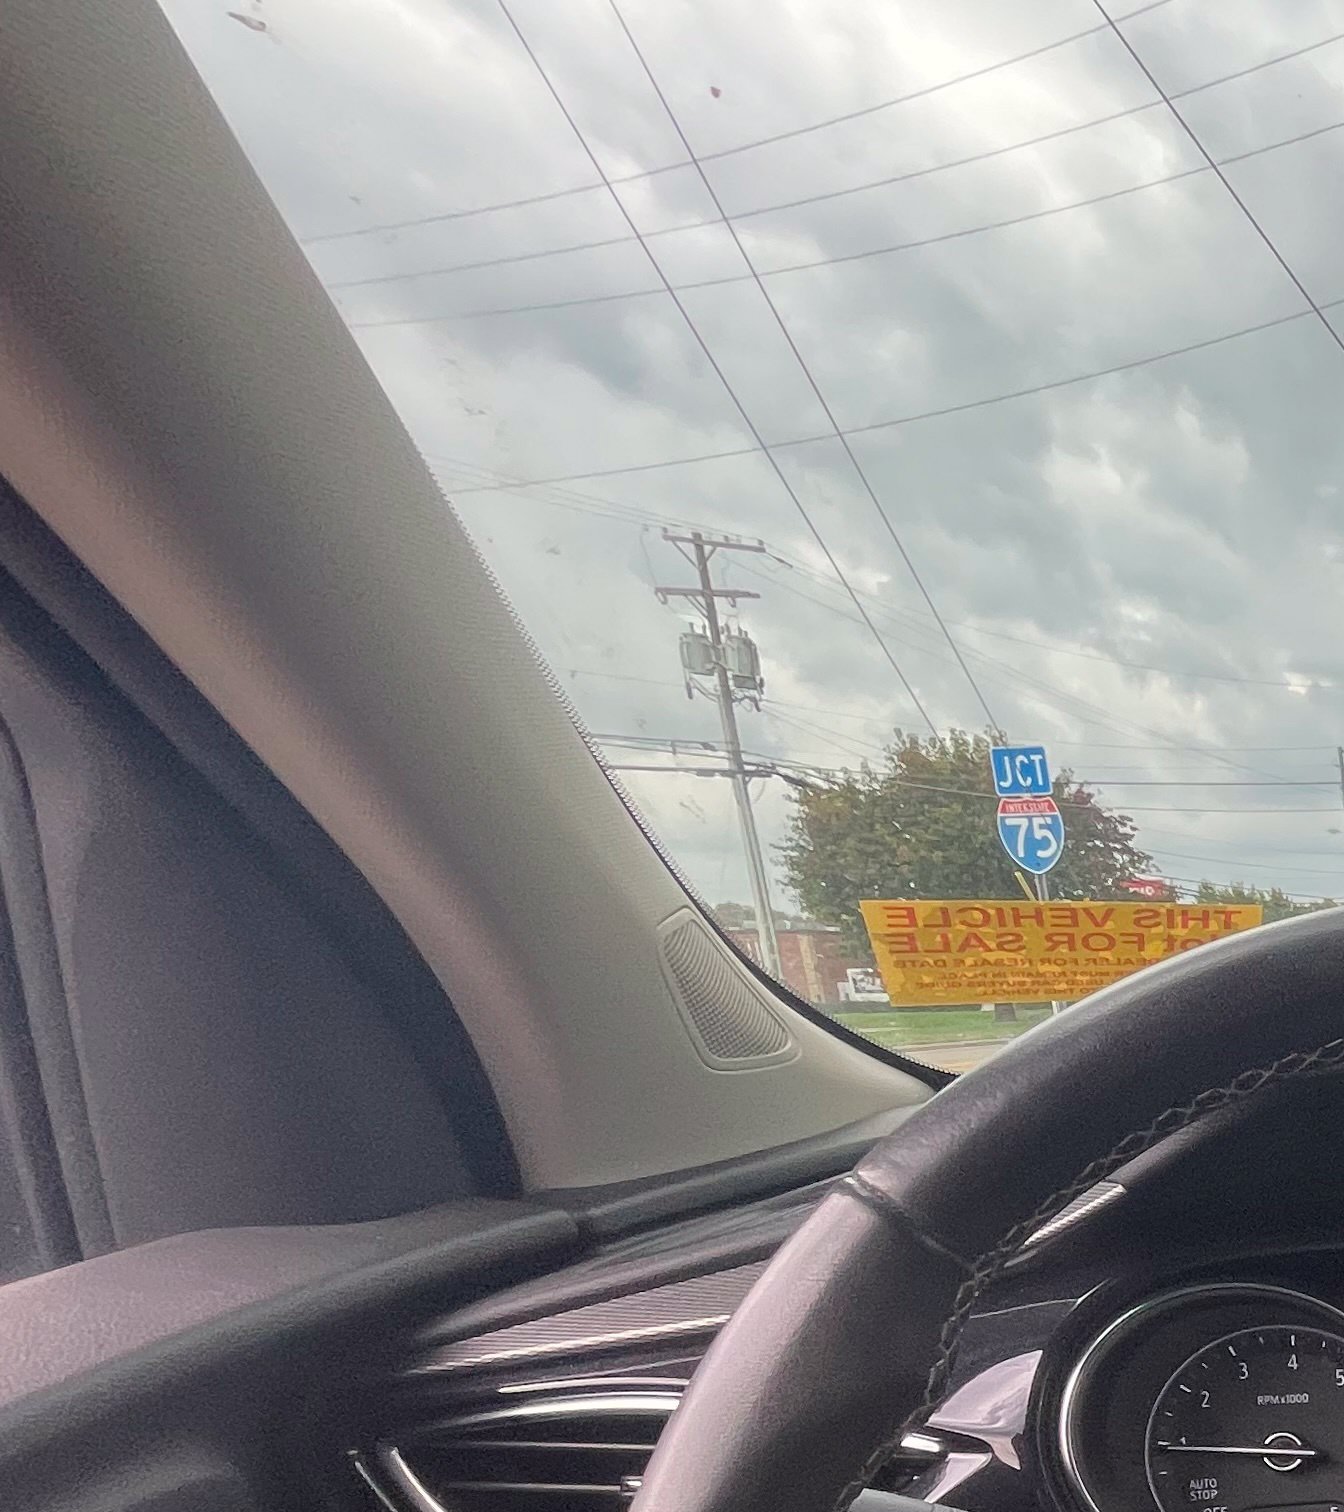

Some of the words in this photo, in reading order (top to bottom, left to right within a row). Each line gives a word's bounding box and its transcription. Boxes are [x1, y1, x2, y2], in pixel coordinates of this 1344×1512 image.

[999, 754, 1044, 788] JCT
[1004, 817, 1058, 859] 75
[1238, 1362, 1249, 1380] 3
[1287, 1353, 1299, 1371] 4
[1201, 1390, 1211, 1409] 2
[1189, 1477, 1218, 1490] AUTO
[1189, 1489, 1218, 1502] STOP
